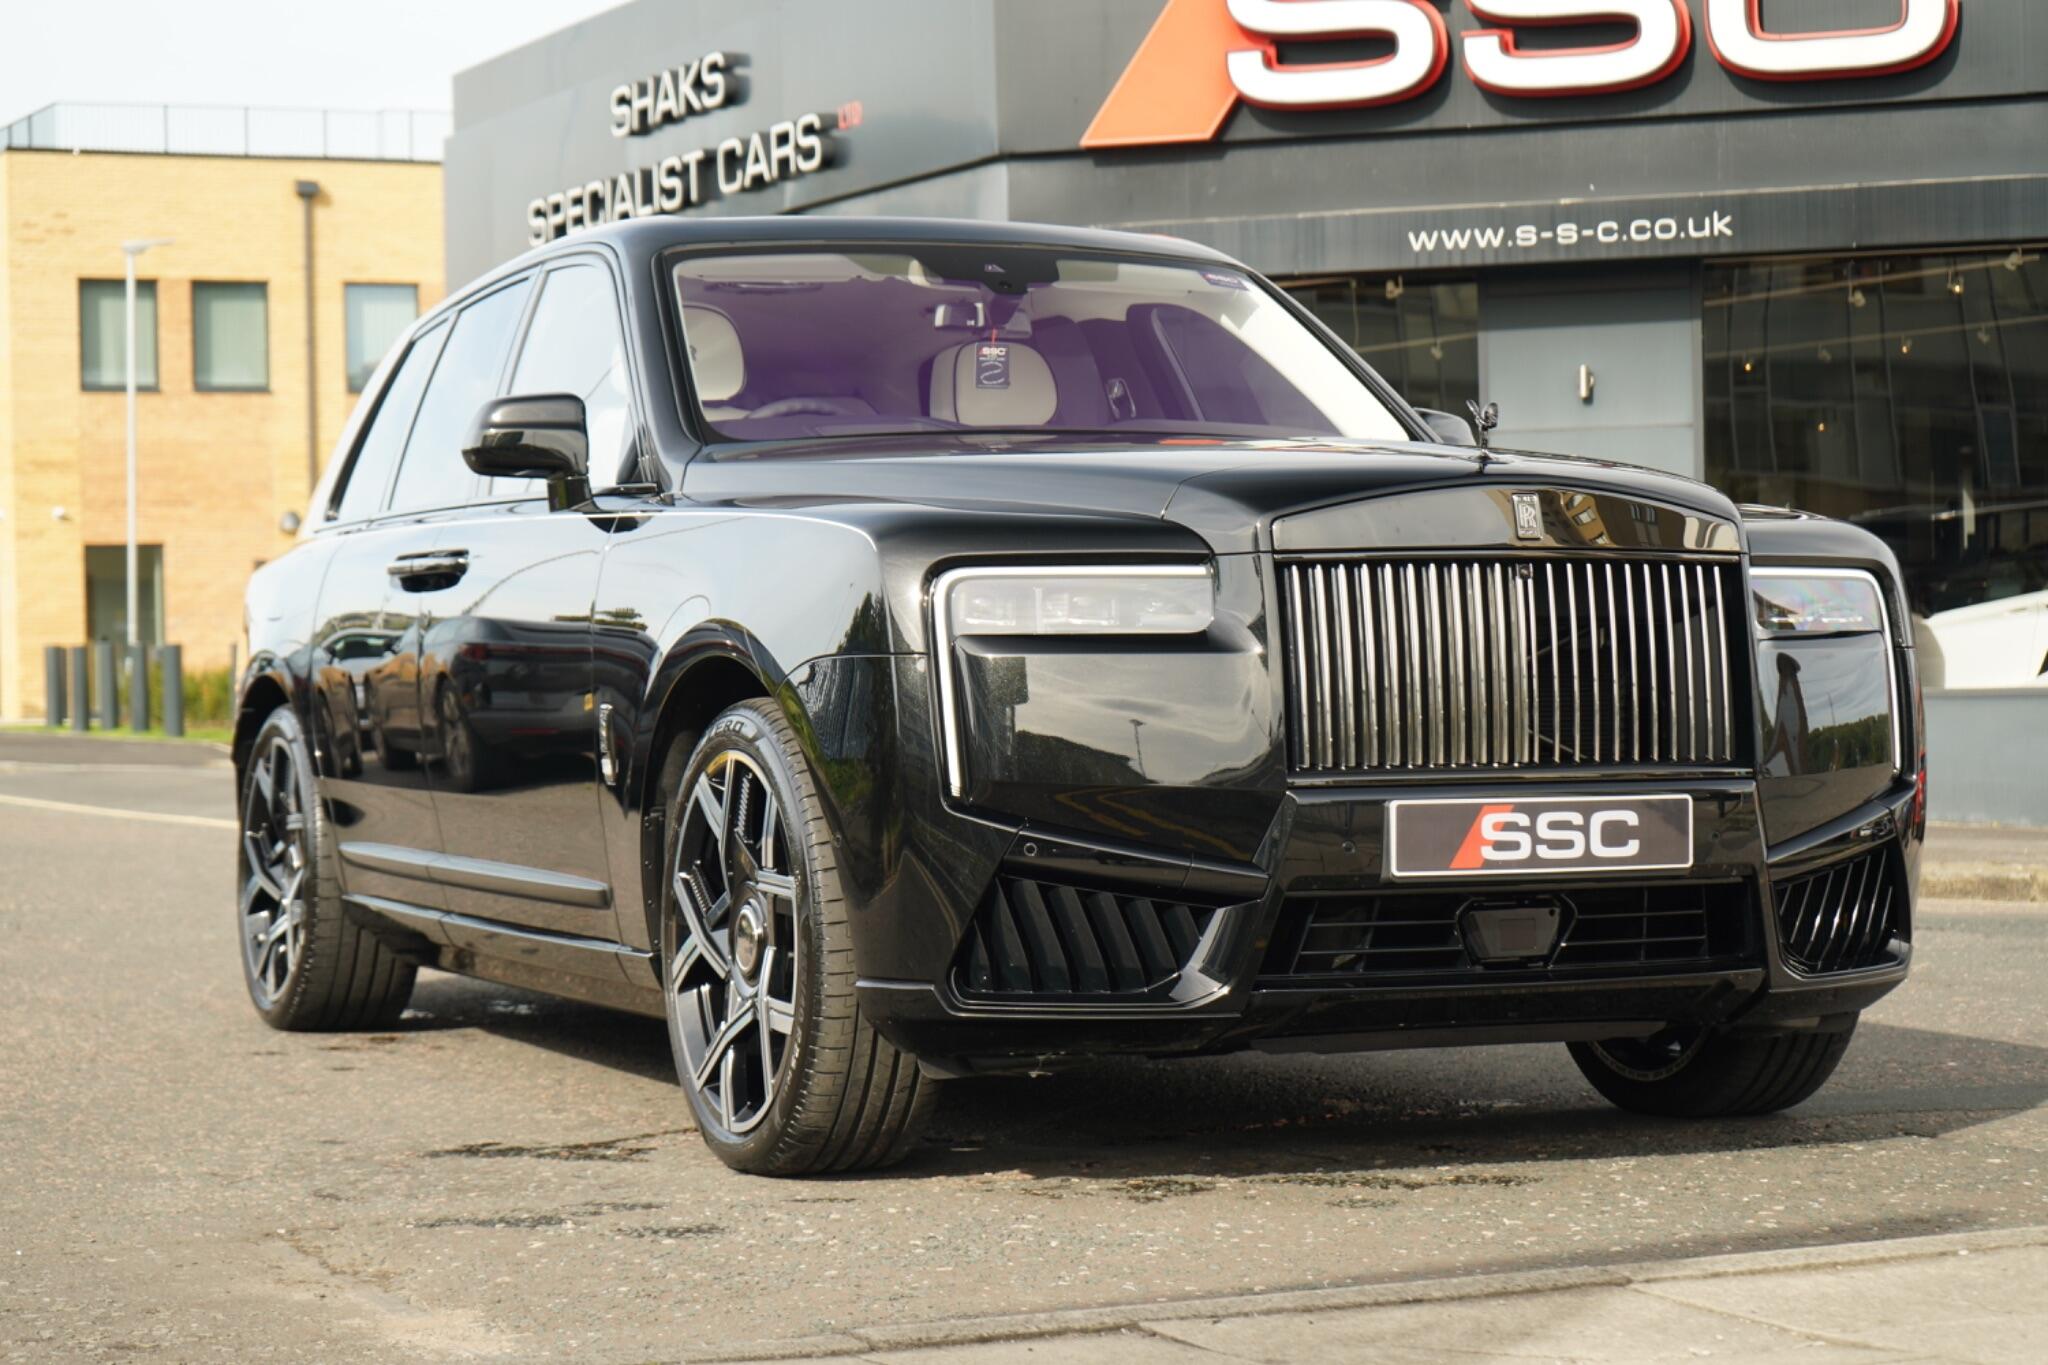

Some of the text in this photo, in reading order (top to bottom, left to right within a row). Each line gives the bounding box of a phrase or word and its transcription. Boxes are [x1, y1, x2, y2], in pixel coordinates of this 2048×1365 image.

[610, 51, 727, 138] SHAKS
[527, 149, 705, 248] SPECIALIST
[716, 112, 823, 195] CARS
[1407, 210, 1734, 252] www.s-s-c.co.uk
[1480, 809, 1641, 861] SSC
